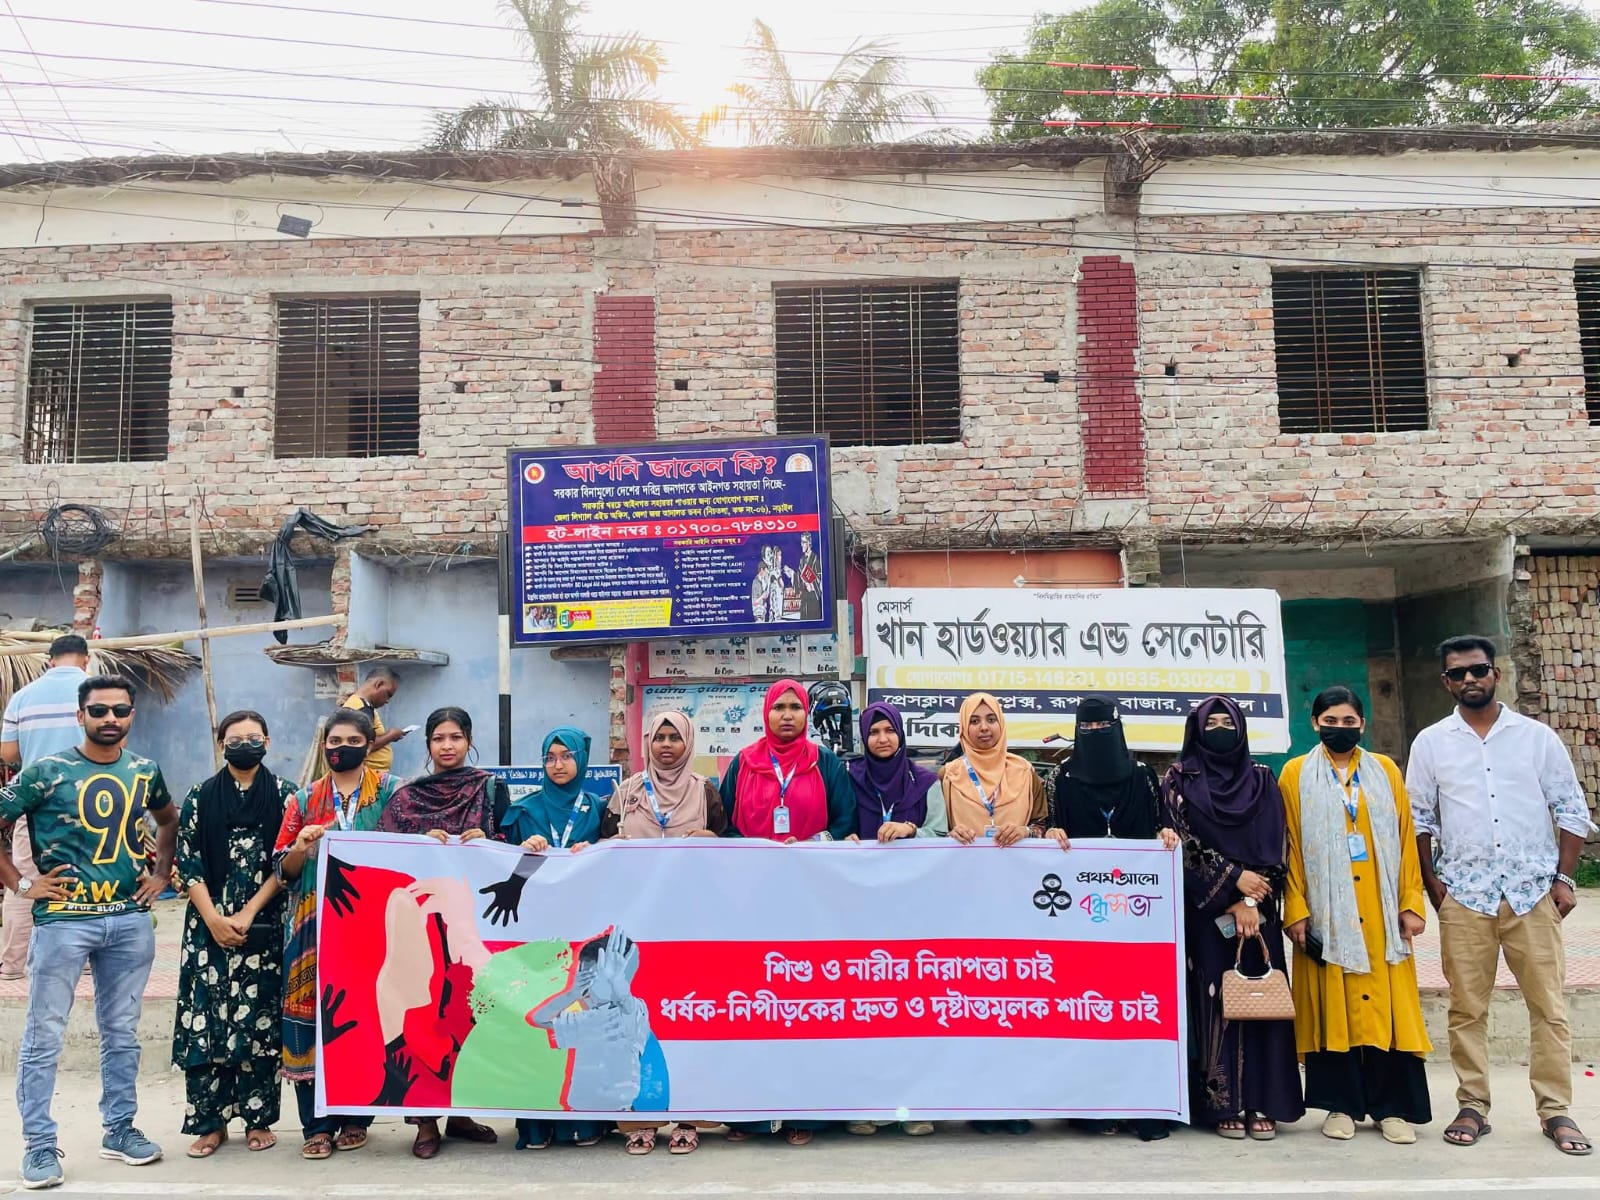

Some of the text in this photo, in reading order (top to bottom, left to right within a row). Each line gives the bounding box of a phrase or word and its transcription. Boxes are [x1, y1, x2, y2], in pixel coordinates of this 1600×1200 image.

[562, 450, 777, 482] আপনি জানেন কি?
[553, 488, 579, 499] সরকার
[581, 484, 615, 500] বিনামূল্যে
[617, 485, 640, 497] দেশের
[545, 524, 613, 541] হট-লাইন
[616, 525, 649, 537] নম্বর
[667, 519, 797, 535] ০১৭০০-৭৮৪৩১০
[877, 597, 913, 614] মেসার্স
[876, 608, 1269, 665] খান হার্ডওয়্যার এন্ড সেনেটারি
[883, 693, 957, 708] প্রেসক্লাব
[1118, 695, 1182, 713] বাজার,
[78, 773, 152, 865] 96
[1080, 893, 1163, 923] বন্ধুসভা
[764, 949, 1056, 983] শিশু ও নারীর নিরাপত্তা চাই
[660, 987, 1162, 1029] ধর্ষক-নিপীড়কের দ্রুত ও দৃষ্টান্তমূলক শাস্তি চাই
